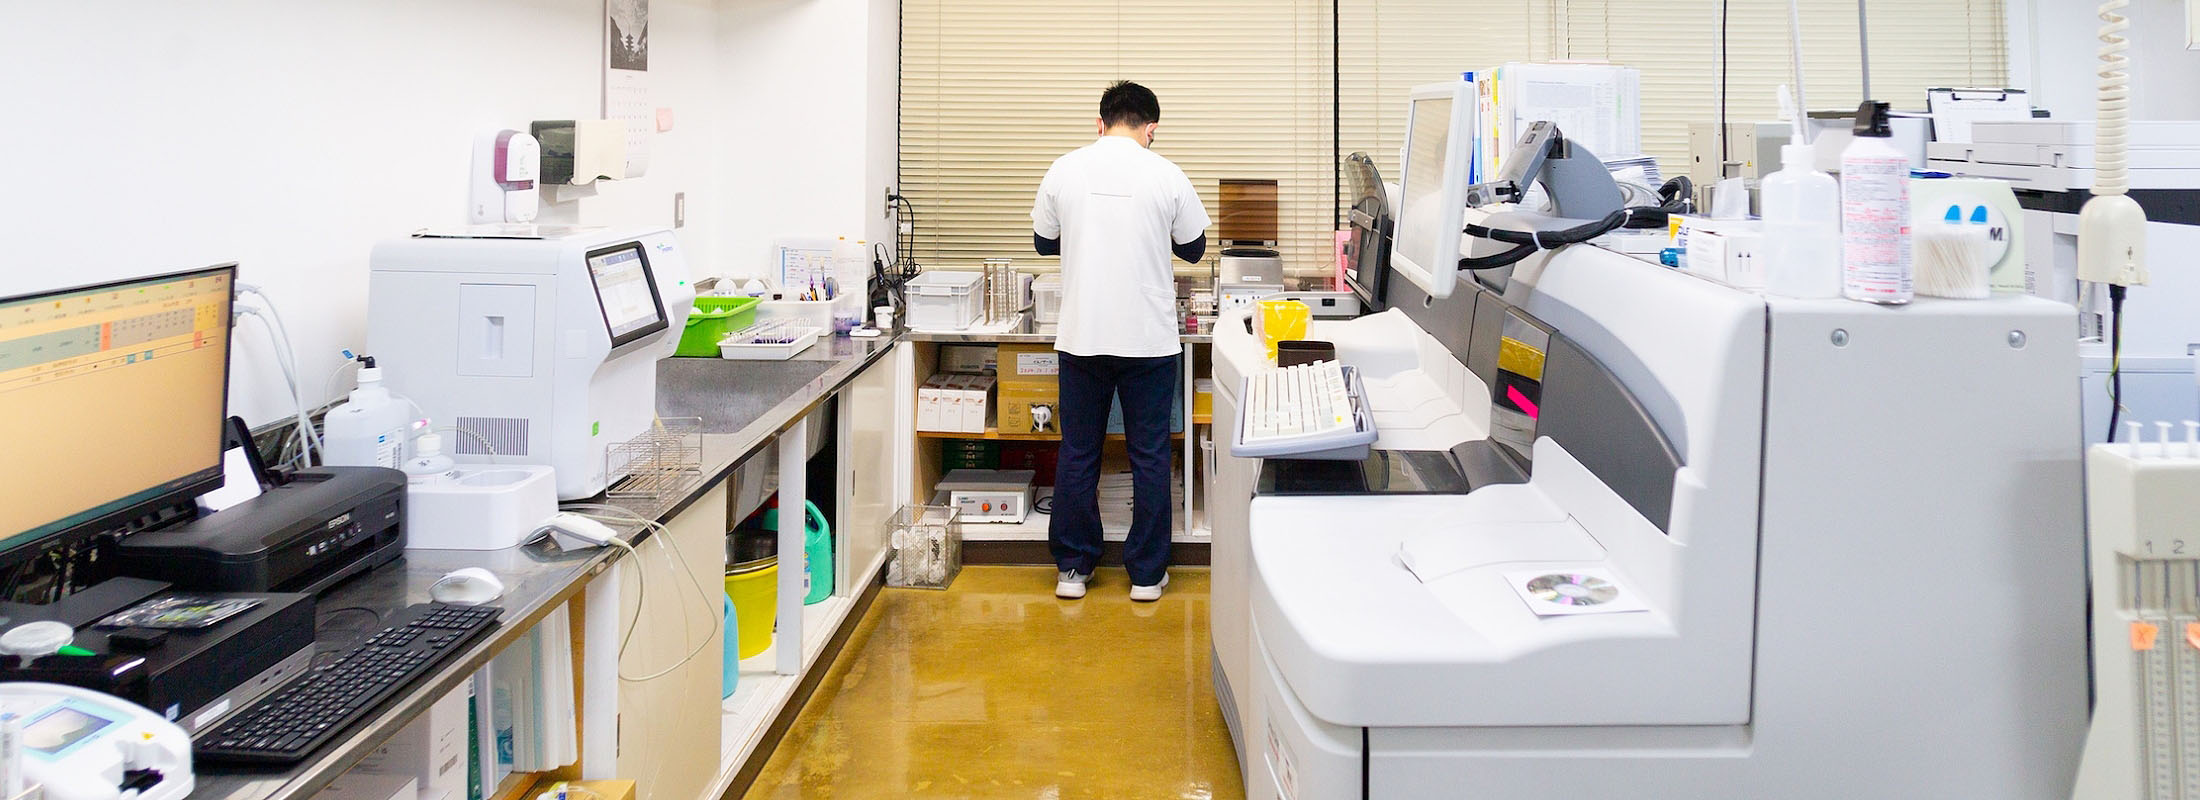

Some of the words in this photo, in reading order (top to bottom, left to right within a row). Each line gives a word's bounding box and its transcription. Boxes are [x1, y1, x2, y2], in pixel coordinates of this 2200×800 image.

[328, 512, 350, 530] EPSON
[2145, 540, 2153, 554] 1
[2173, 540, 2185, 554] 2
